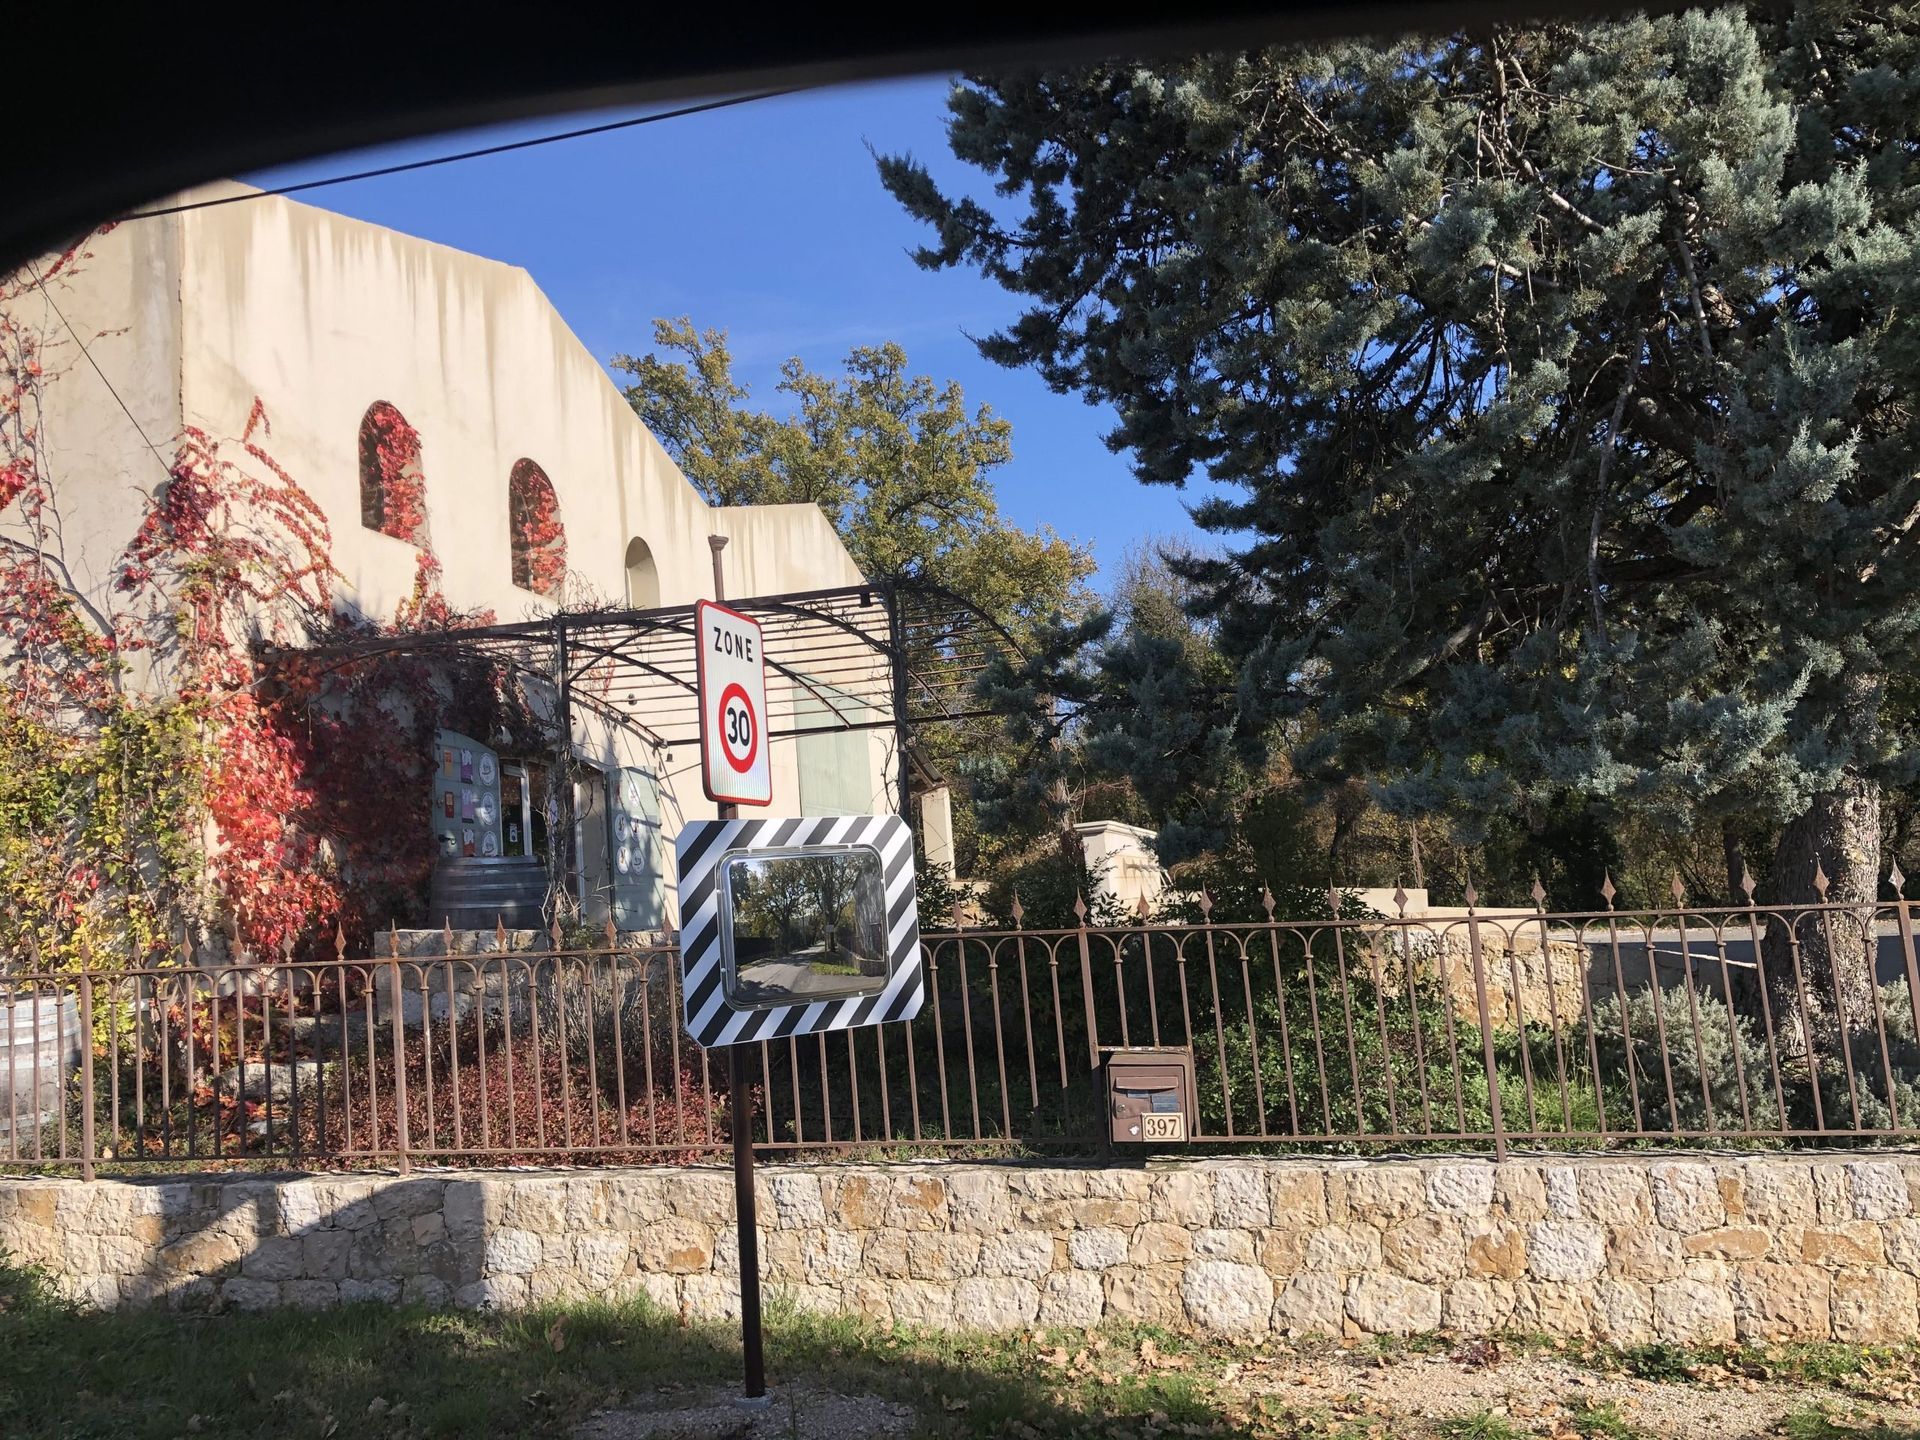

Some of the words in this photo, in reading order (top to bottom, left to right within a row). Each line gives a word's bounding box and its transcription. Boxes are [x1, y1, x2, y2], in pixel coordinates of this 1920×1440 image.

[713, 627, 753, 662] ZONE
[727, 707, 750, 747] 30
[1147, 1119, 1177, 1136] 397
